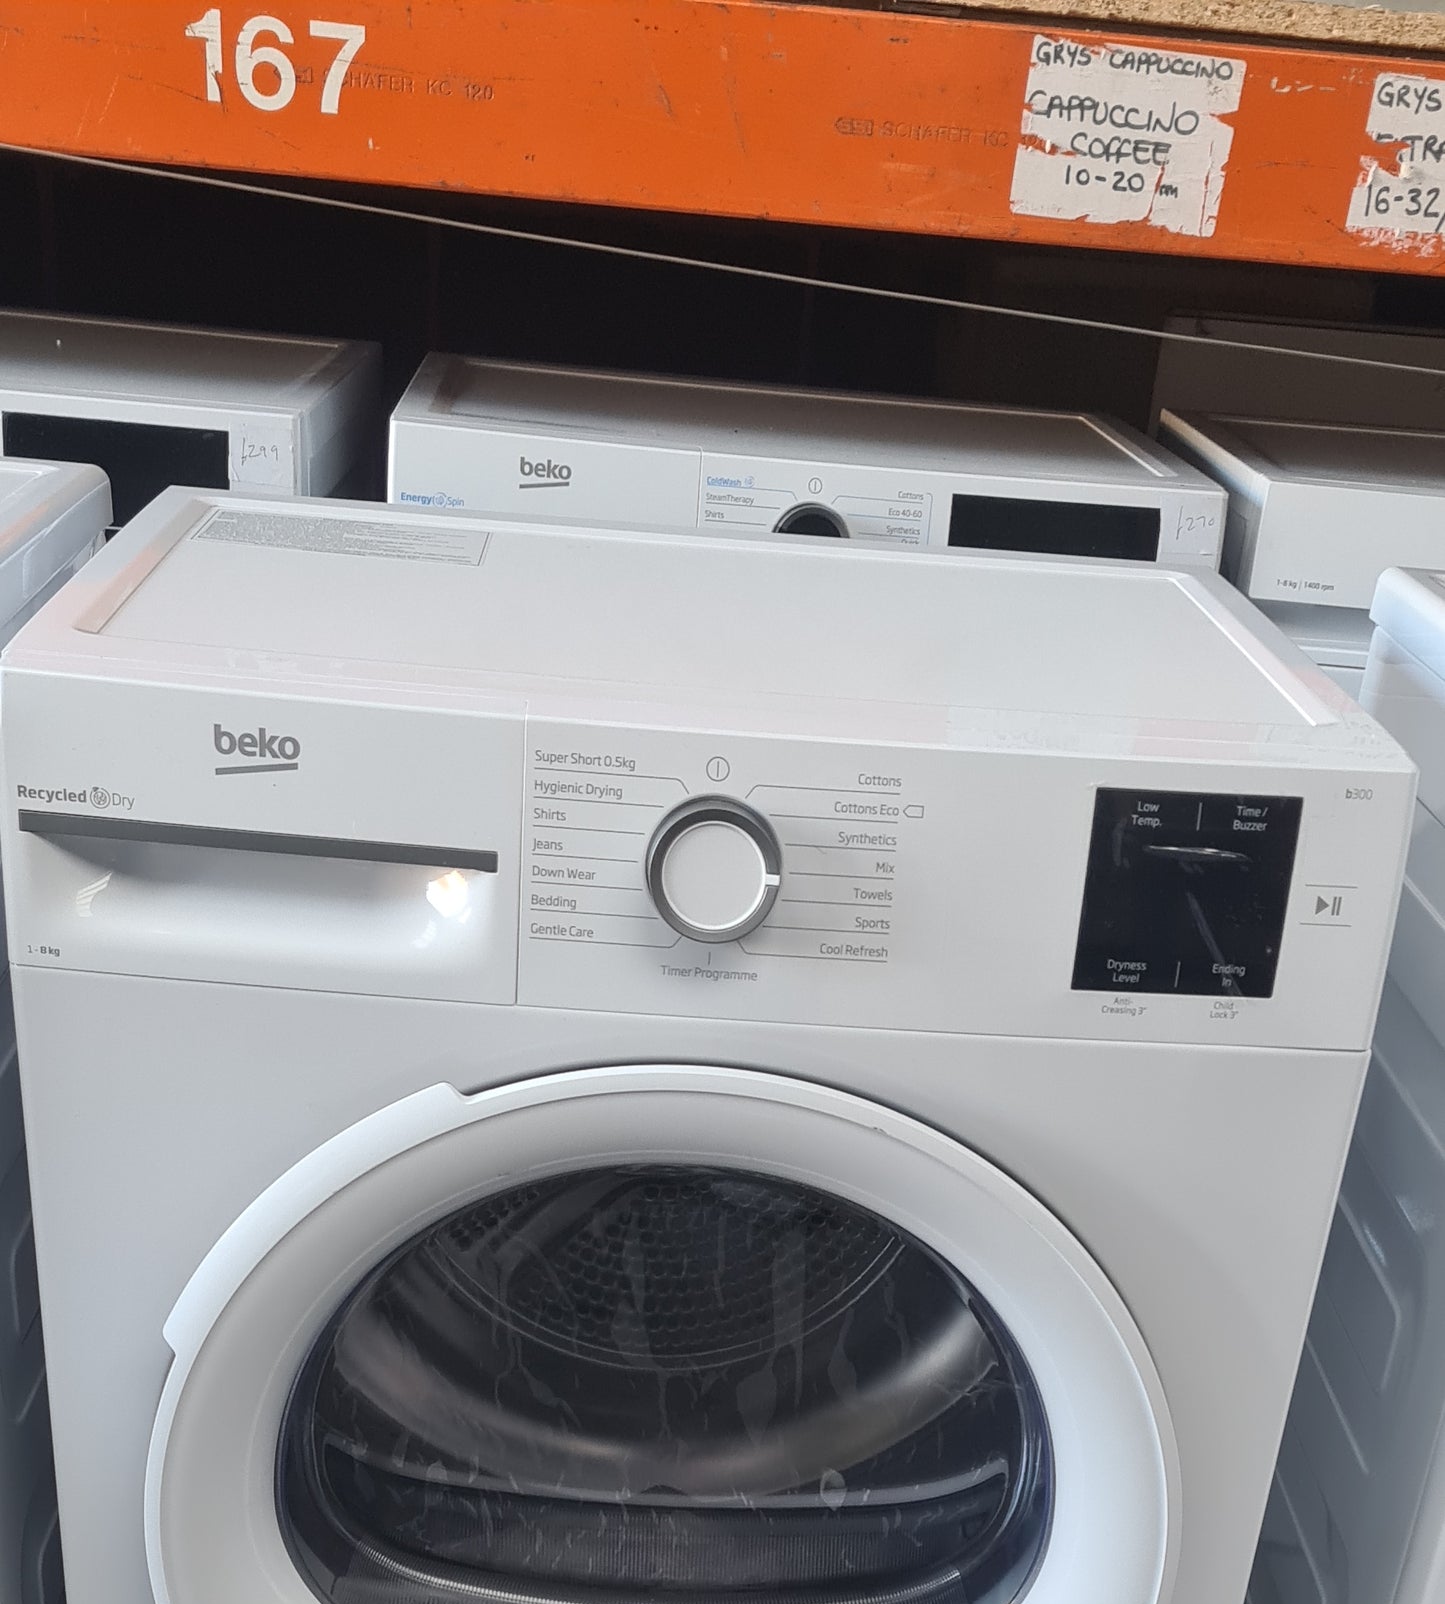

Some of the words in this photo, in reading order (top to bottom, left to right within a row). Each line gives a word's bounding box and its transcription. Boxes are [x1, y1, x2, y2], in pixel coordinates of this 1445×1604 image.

[185, 8, 366, 115] 167
[1036, 41, 1092, 68] GRYS
[1109, 49, 1234, 81] CAPPUCCINO
[322, 69, 415, 93] HAFER
[1377, 81, 1442, 115] GRYS
[1029, 90, 1200, 136] CAPPUCCINO
[1071, 132, 1172, 166] COFFEE
[1065, 165, 1145, 193] 10-20
[241, 437, 279, 466] £299
[520, 456, 572, 480] beko
[706, 476, 742, 488] ColdWash
[400, 492, 432, 506] Energy
[447, 497, 465, 508] Spin
[705, 493, 755, 505] SteamTherapy
[704, 510, 725, 520] Shirts
[888, 508, 901, 517] Eco
[901, 508, 923, 519] 40-60
[886, 525, 921, 536] Synthetics
[213, 723, 301, 760] beko
[535, 750, 569, 765] Super
[570, 753, 603, 767] Short
[603, 756, 637, 772] 0.5kg
[857, 773, 903, 788] Cottons
[16, 784, 88, 804] Recycled
[111, 793, 136, 811] Dry
[533, 780, 583, 796] Hygienic
[585, 784, 624, 800] Drying
[1345, 788, 1374, 801] b300
[834, 801, 879, 816] Cottons
[879, 804, 900, 817] Eco
[1137, 801, 1160, 813] Low
[1236, 806, 1260, 818] Time
[533, 808, 568, 822] Shirts
[1131, 815, 1163, 828] Temp.
[1232, 820, 1268, 832] Buzzer
[532, 838, 564, 852] Jeans
[838, 831, 898, 847] Synthetics
[531, 865, 566, 880] Down
[566, 868, 597, 881] Wear
[875, 862, 896, 875] Mix
[530, 894, 578, 911] Bedding
[853, 888, 894, 902] Towels
[530, 922, 568, 938] Gentle
[568, 925, 595, 938] Care
[855, 917, 891, 931] Sports
[819, 943, 844, 956] Cool
[845, 945, 889, 959] Refresh
[1107, 959, 1148, 973] Dryness
[1211, 963, 1247, 978] Ending
[661, 965, 694, 980] Timer
[694, 967, 759, 984] Programme
[1112, 972, 1141, 984] Level
[1221, 976, 1233, 987] In
[1101, 1005, 1138, 1017] Creasing
[1213, 1001, 1234, 1011] Child
[1209, 1010, 1230, 1020] Lock
